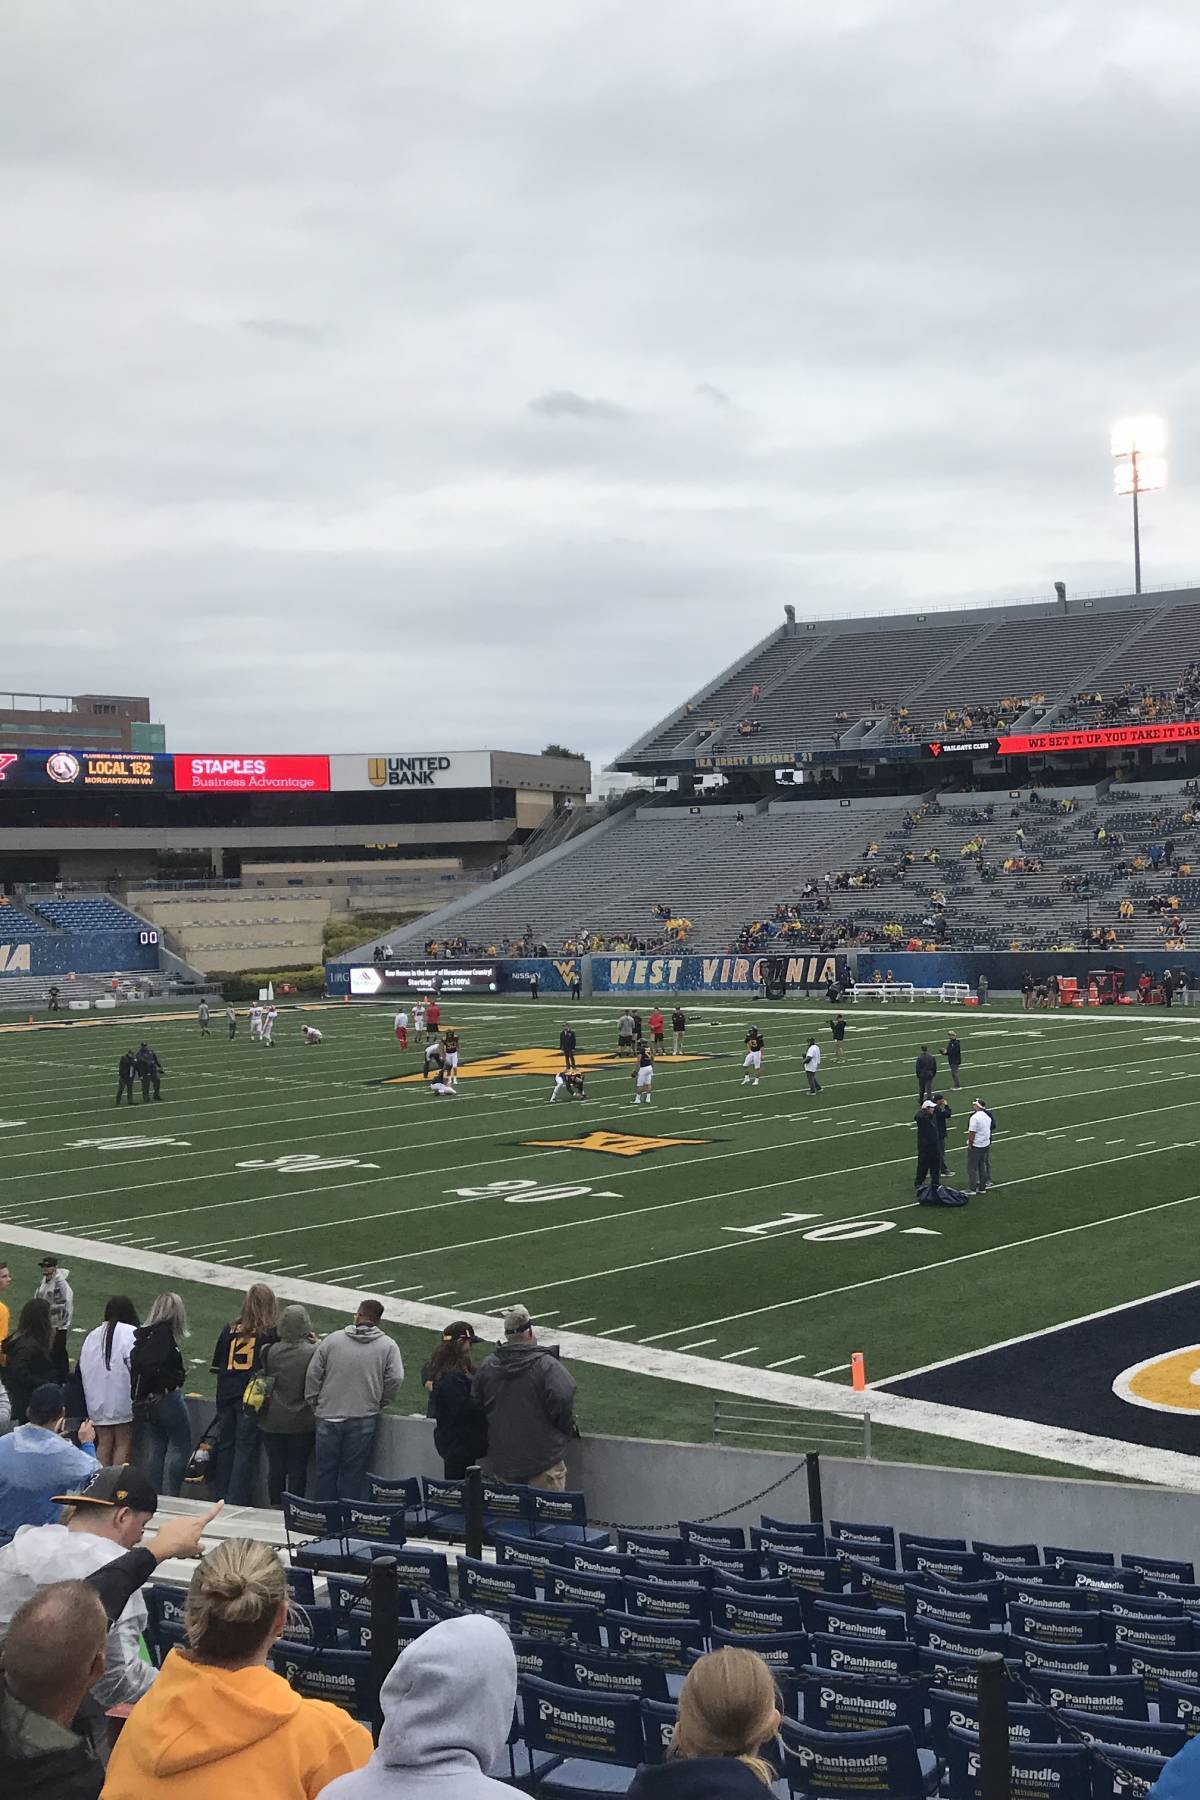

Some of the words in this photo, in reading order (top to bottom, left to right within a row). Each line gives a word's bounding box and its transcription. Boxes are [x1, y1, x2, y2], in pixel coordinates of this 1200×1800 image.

[1028, 738, 1047, 748] WE
[1049, 736, 1071, 747] SET
[1072, 734, 1084, 745] IT
[1104, 731, 1128, 743] YOU
[1130, 729, 1160, 741] TAKE
[1162, 728, 1175, 738] IT
[942, 743, 972, 752] TAILGATE
[972, 741, 989, 751] CLUB
[88, 761, 129, 775] LOCAL
[130, 762, 151, 775] 152
[191, 759, 266, 775] STAPLES
[388, 757, 451, 772] UNITED
[84, 777, 140, 785] MORGANTOWN
[141, 777, 153, 785] WV
[192, 776, 246, 787] Business
[248, 777, 315, 788] Advantage
[389, 771, 435, 786] BANK
[330, 972, 350, 983] IMG
[610, 960, 682, 985] WEST
[407, 978, 432, 986] Starting
[442, 1180, 592, 1203] 20
[722, 1212, 897, 1242] 10
[227, 1337, 257, 1371] 13
[697, 1536, 730, 1545] Panhandle
[848, 1534, 880, 1542] Panhandle
[514, 1550, 549, 1564] Panhandle
[636, 1545, 669, 1556] Panhandle
[845, 1553, 880, 1562] Panhandle
[396, 1566, 429, 1574] anhandle
[582, 1562, 620, 1575] Panhandle
[709, 1560, 743, 1569] Panhandle
[926, 1564, 962, 1572] Panhandle
[788, 1567, 824, 1577] Panhandle
[1144, 1570, 1180, 1580] Panhandle
[476, 1576, 515, 1589] Panhandle
[1086, 1579, 1124, 1590] Panhandle
[566, 1585, 606, 1600] Panhandle
[646, 1599, 690, 1610] Panhandle
[1027, 1598, 1070, 1609] Panhandle
[736, 1607, 782, 1621] Panhandle
[926, 1604, 970, 1620] Panhandle
[840, 1622, 886, 1636] Panhandle
[1035, 1622, 1082, 1633] Panhandle
[631, 1632, 681, 1646] Panhandle
[1128, 1629, 1176, 1642] Panhandle
[844, 1655, 897, 1670] Panhandle
[1038, 1658, 1089, 1671] Panhandle
[1145, 1664, 1198, 1678] Panhandle
[588, 1670, 642, 1686] Panhandle
[835, 1694, 896, 1710] Panhandle
[1066, 1694, 1123, 1706] Panhandle
[554, 1709, 614, 1729] Panhandle
[814, 1754, 887, 1767] Panhandle
[1011, 1767, 1060, 1781] handle
